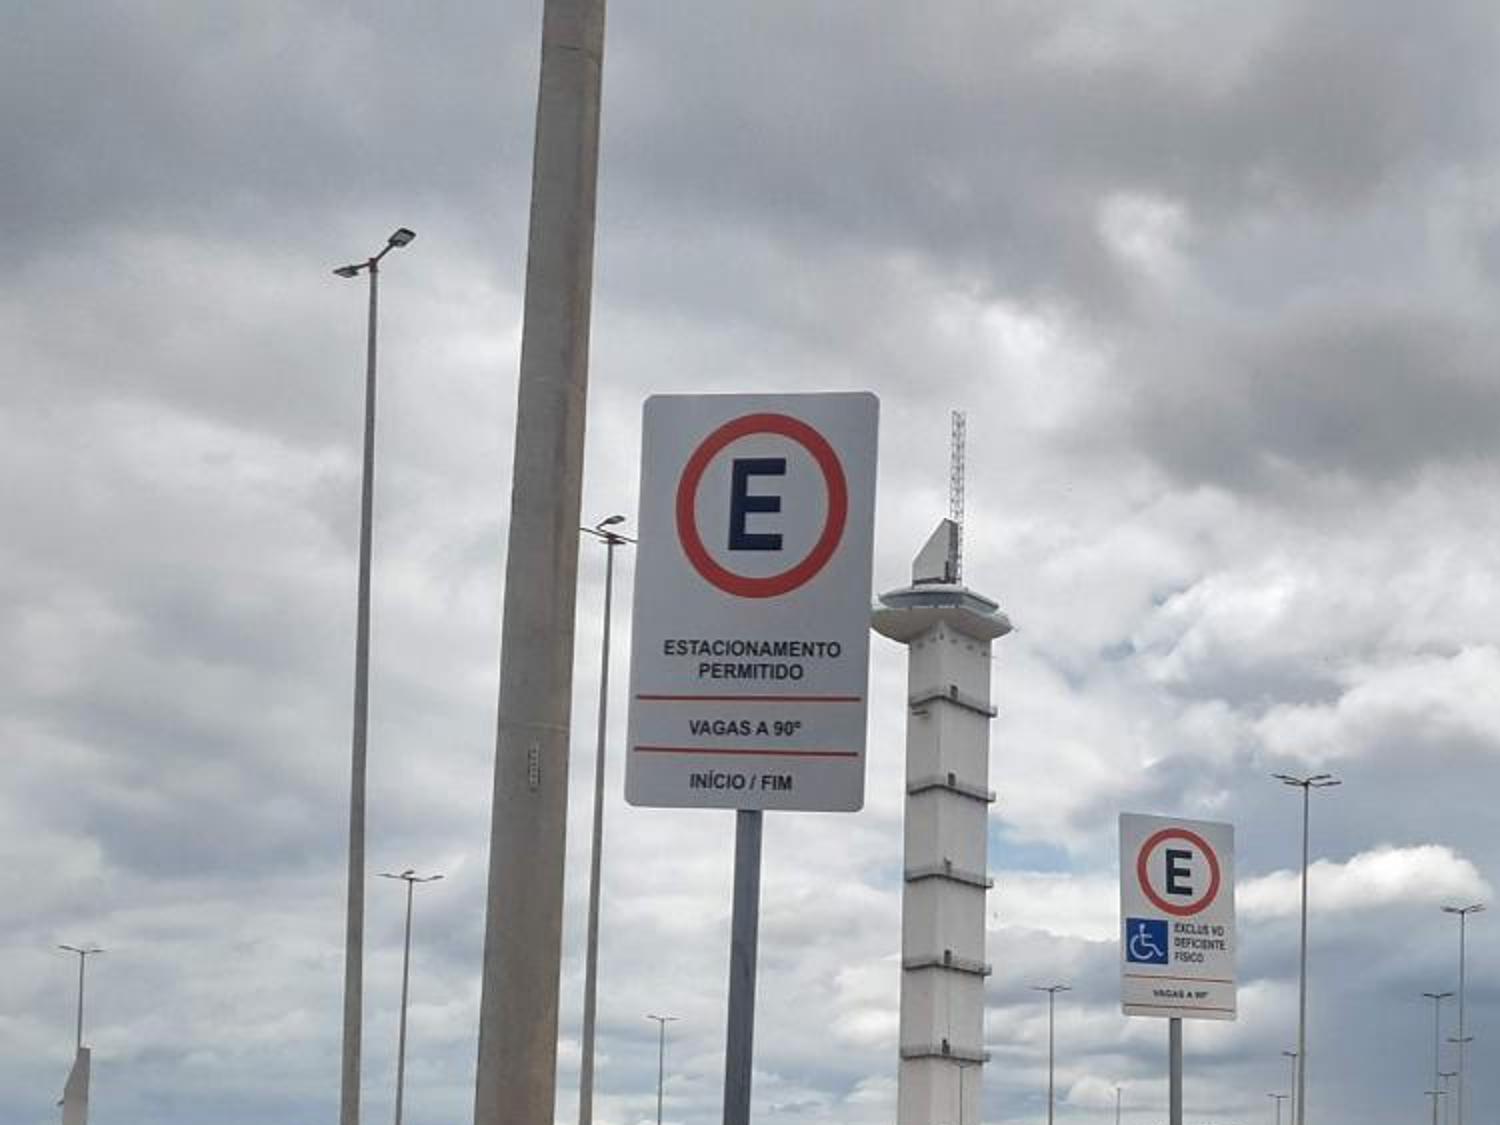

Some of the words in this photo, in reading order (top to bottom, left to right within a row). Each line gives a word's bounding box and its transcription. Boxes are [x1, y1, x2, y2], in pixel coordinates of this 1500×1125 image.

[728, 458, 787, 551] E
[663, 639, 841, 658] ESTACIONAMENTO
[698, 663, 804, 680] PERMITIDO
[689, 719, 750, 736] VAGAS
[756, 720, 769, 736] A
[690, 769, 746, 790] INÍCIO
[761, 775, 793, 791] FIM
[1166, 848, 1193, 896] E
